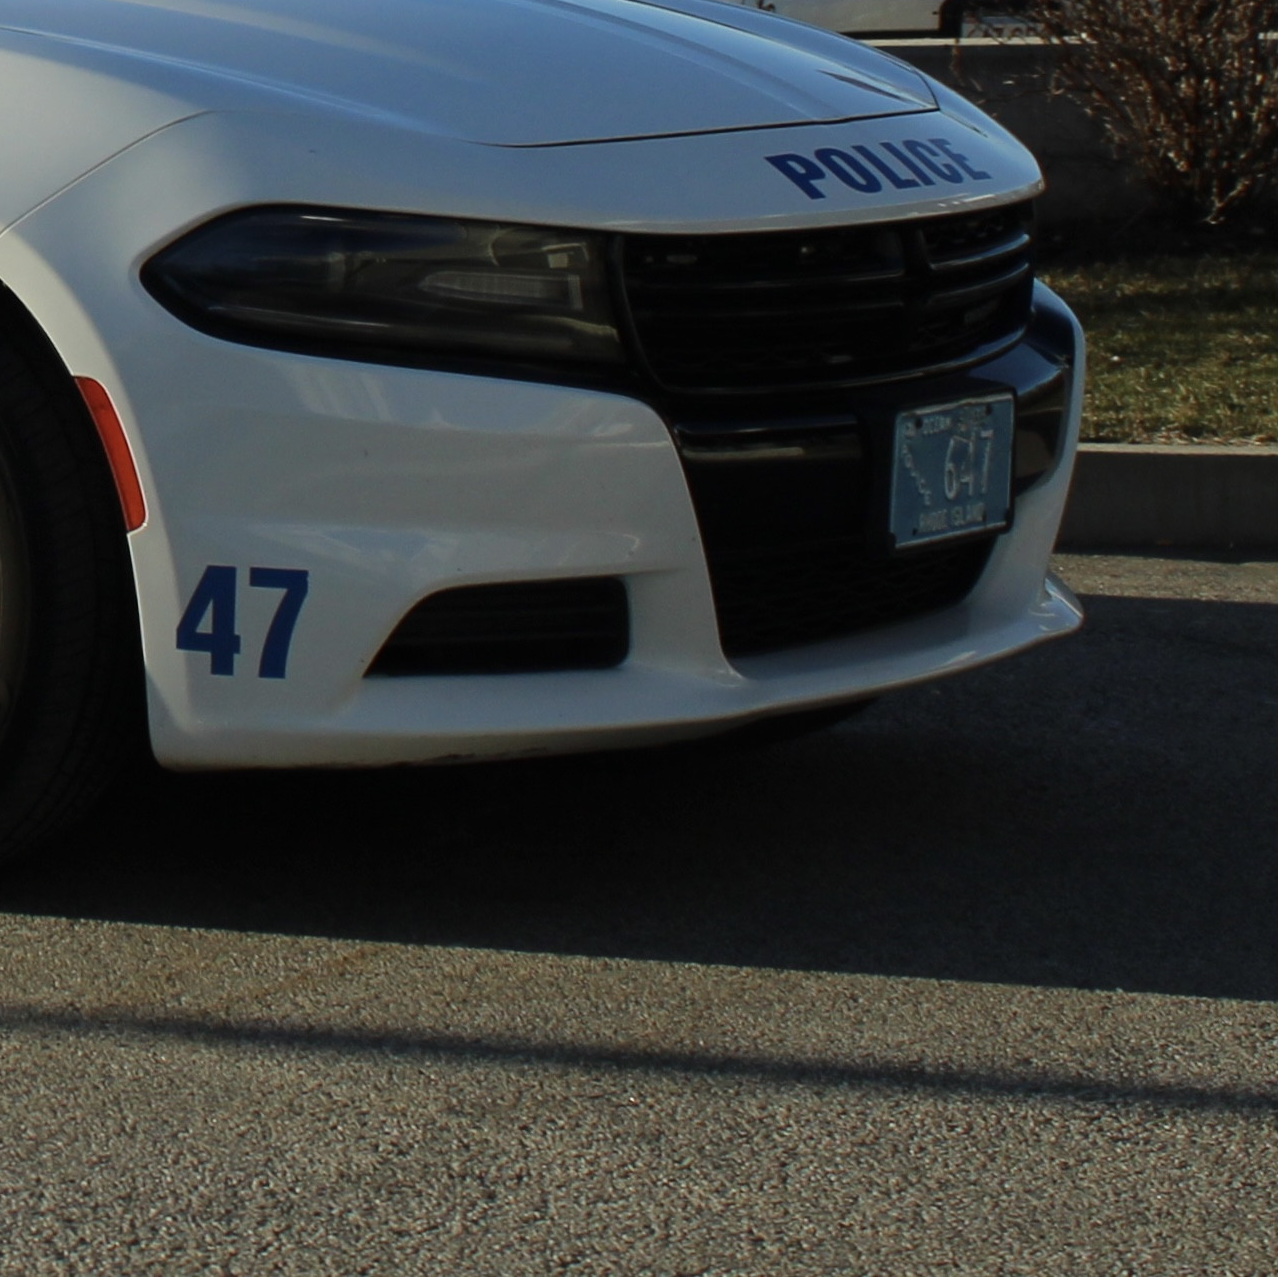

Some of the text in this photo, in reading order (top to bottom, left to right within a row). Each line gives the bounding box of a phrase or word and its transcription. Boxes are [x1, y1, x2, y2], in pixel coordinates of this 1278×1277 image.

[764, 138, 993, 200] POLICE
[943, 428, 995, 501] 647
[175, 564, 310, 680] 47
